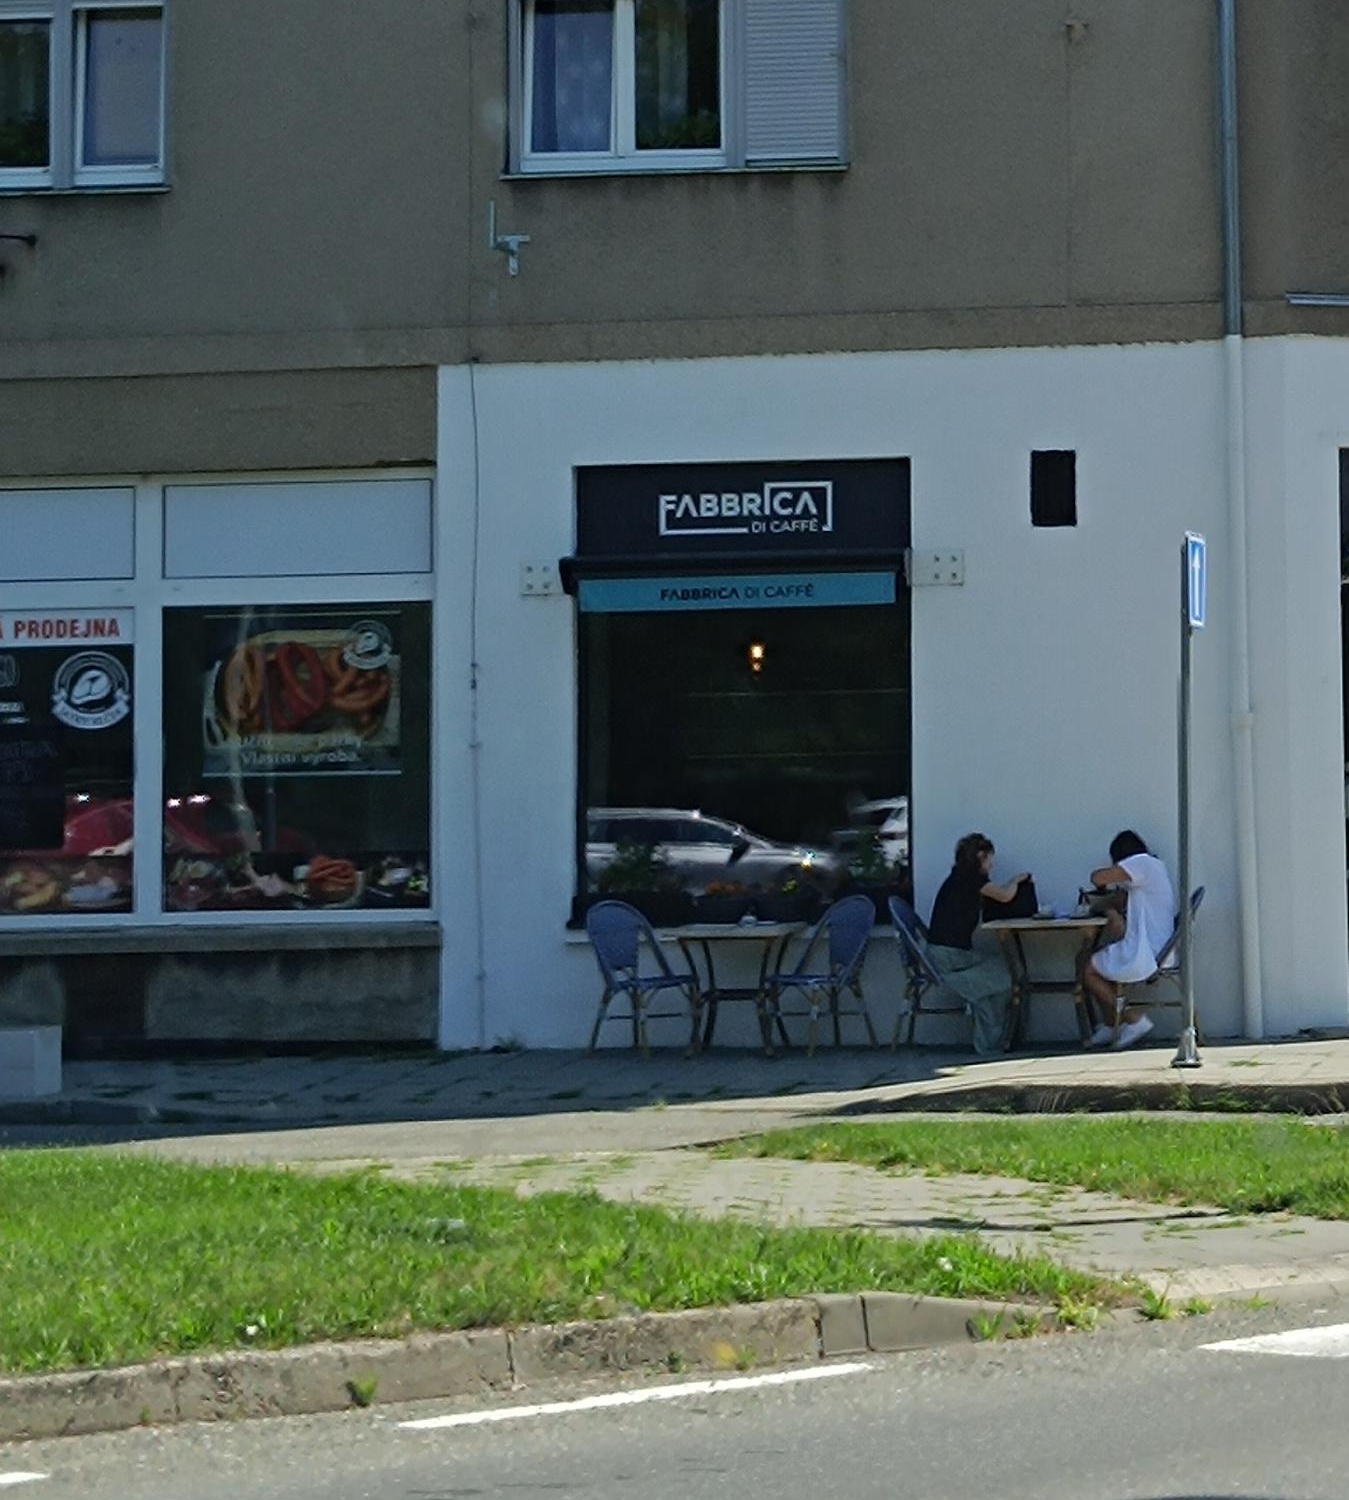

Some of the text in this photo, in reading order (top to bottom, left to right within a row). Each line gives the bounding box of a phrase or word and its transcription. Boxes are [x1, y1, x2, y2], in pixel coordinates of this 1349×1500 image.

[659, 490, 819, 518] FABBRICA
[751, 521, 767, 534] DI
[660, 586, 740, 601] FABBRICA
[744, 586, 760, 599] DI
[13, 618, 121, 639] PRODEJNA
